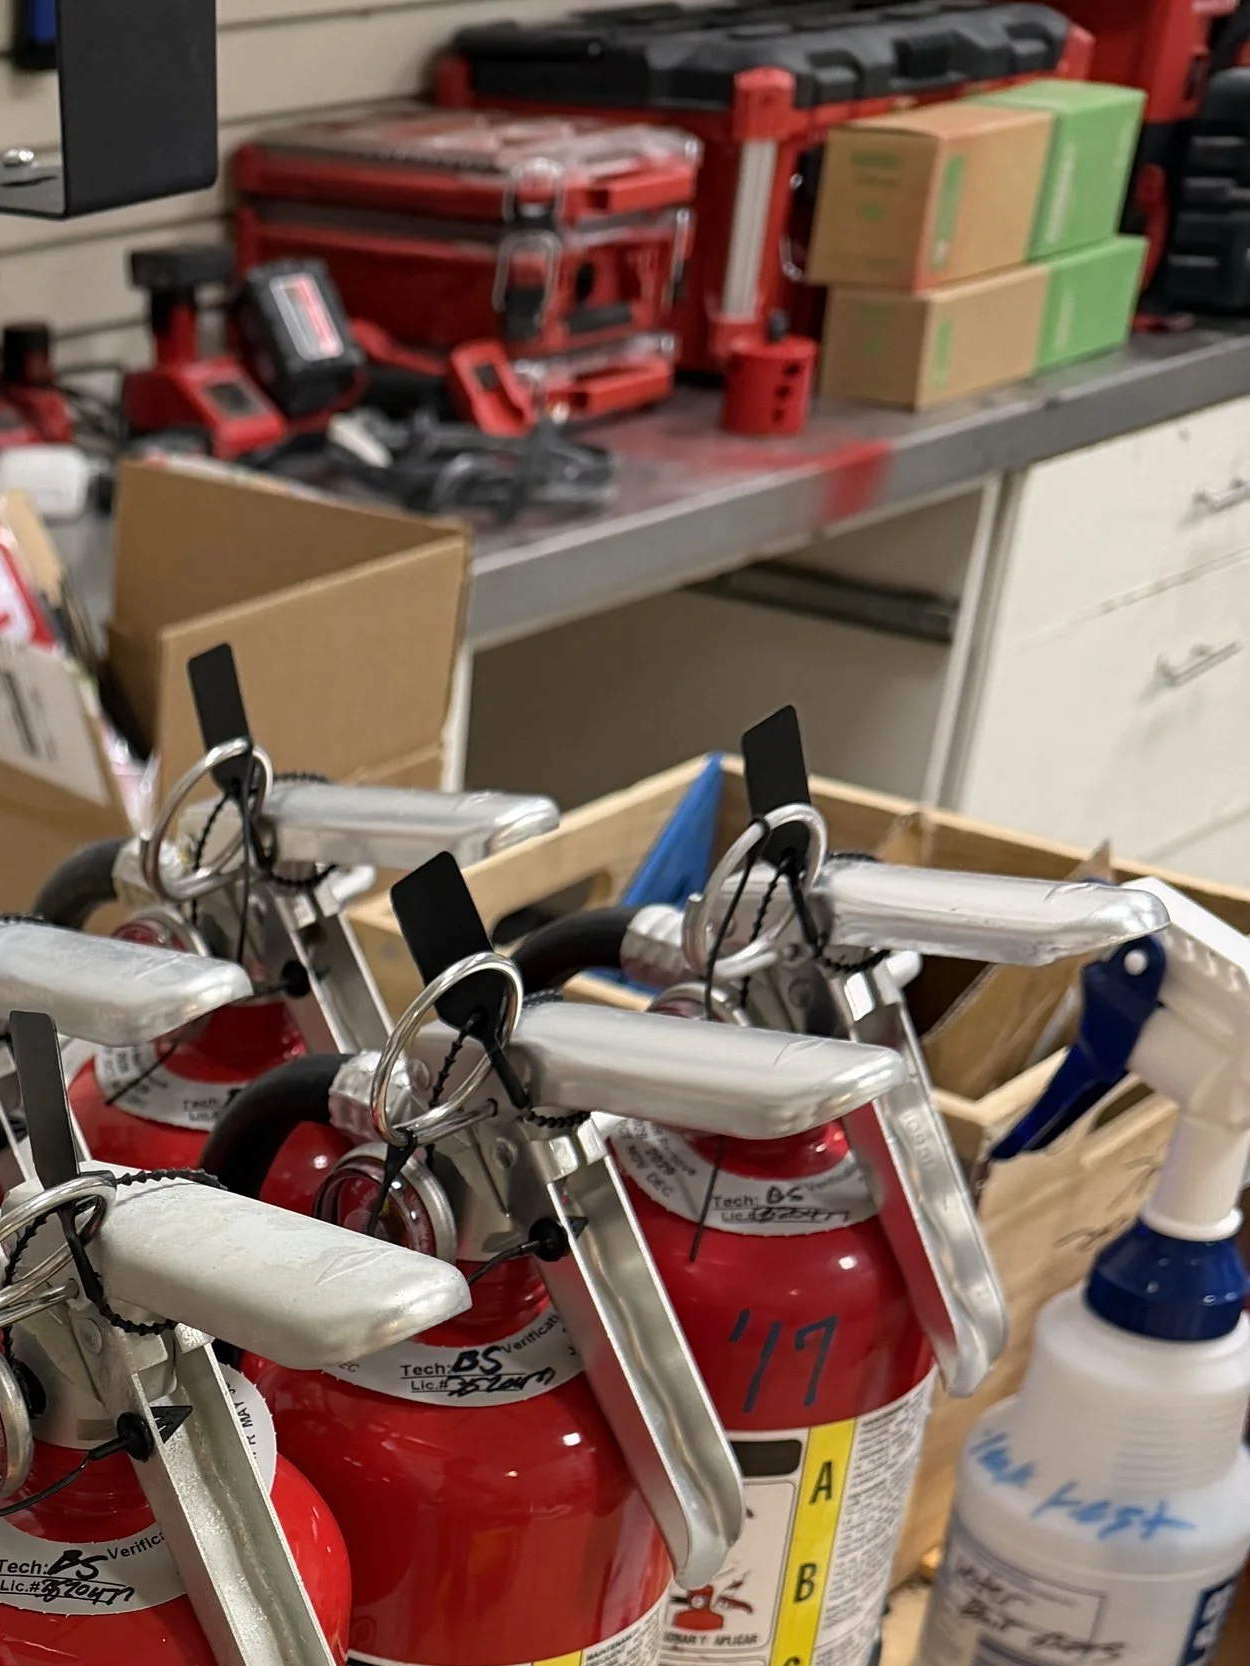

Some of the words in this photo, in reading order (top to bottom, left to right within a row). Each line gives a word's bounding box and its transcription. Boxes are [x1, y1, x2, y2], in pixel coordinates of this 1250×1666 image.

[712, 1195, 758, 1208] Tech:
[500, 1315, 561, 1354] Verificati
[400, 1364, 451, 1377] Tech:
[234, 1401, 253, 1428] MAY
[808, 1460, 834, 1505] A
[0, 1579, 41, 1594] Lic.#
[794, 1562, 817, 1604] B
